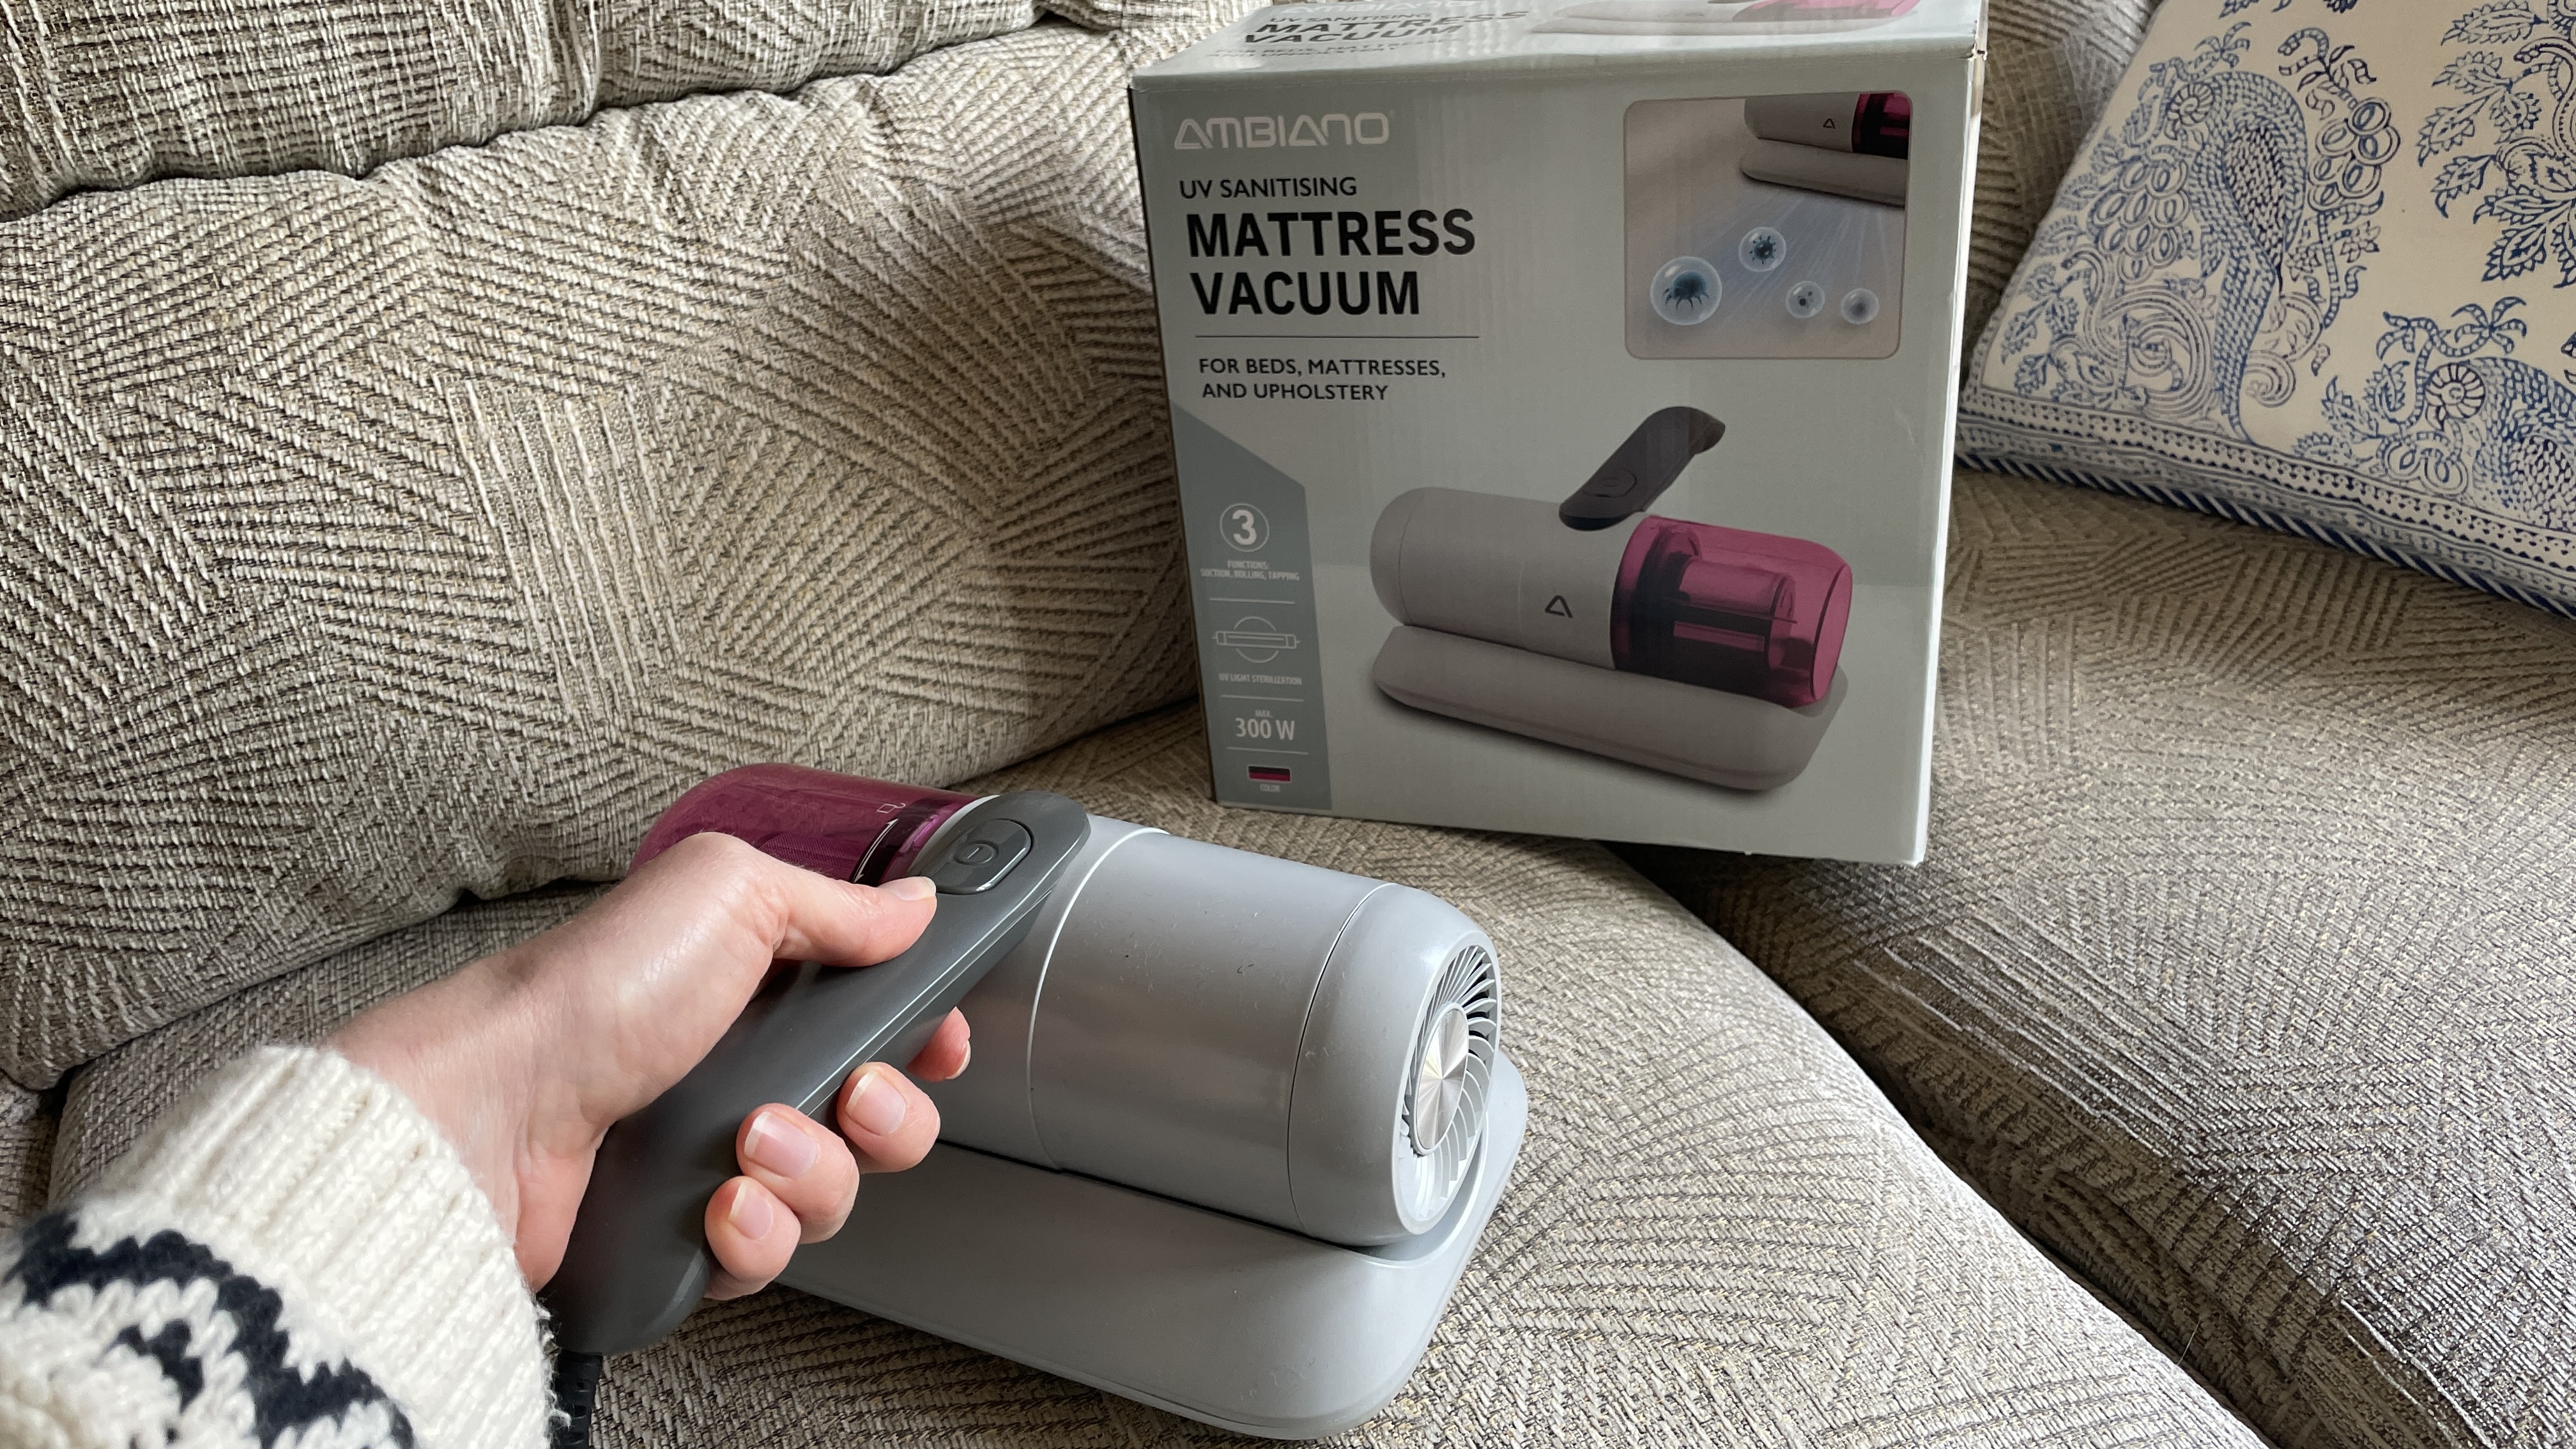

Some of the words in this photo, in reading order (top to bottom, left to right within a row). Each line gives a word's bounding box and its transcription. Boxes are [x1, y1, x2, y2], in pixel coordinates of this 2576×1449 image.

[1255, 11, 1529, 33] MATTRESS
[1245, 26, 1464, 43] VACUUM
[1174, 112, 1390, 150] AMBIANO
[1179, 180, 1213, 199] UV
[1220, 176, 1358, 198] SANITISING
[1186, 209, 1475, 257] MATTRESS
[1190, 271, 1420, 315] VACUUM
[1199, 358, 1239, 374] FOR
[1246, 358, 1301, 377] BEDS,
[1308, 360, 1446, 378] MATTRESSES,
[1202, 383, 1246, 399] AND
[1254, 384, 1389, 401] UPHOLSTERY
[1232, 509, 1257, 545] 3
[1268, 571, 1300, 581] TAPPING
[1219, 673, 1229, 682] UV
[1230, 674, 1250, 682] LIGHT
[1235, 717, 1271, 739] 300
[1275, 719, 1295, 740] W
